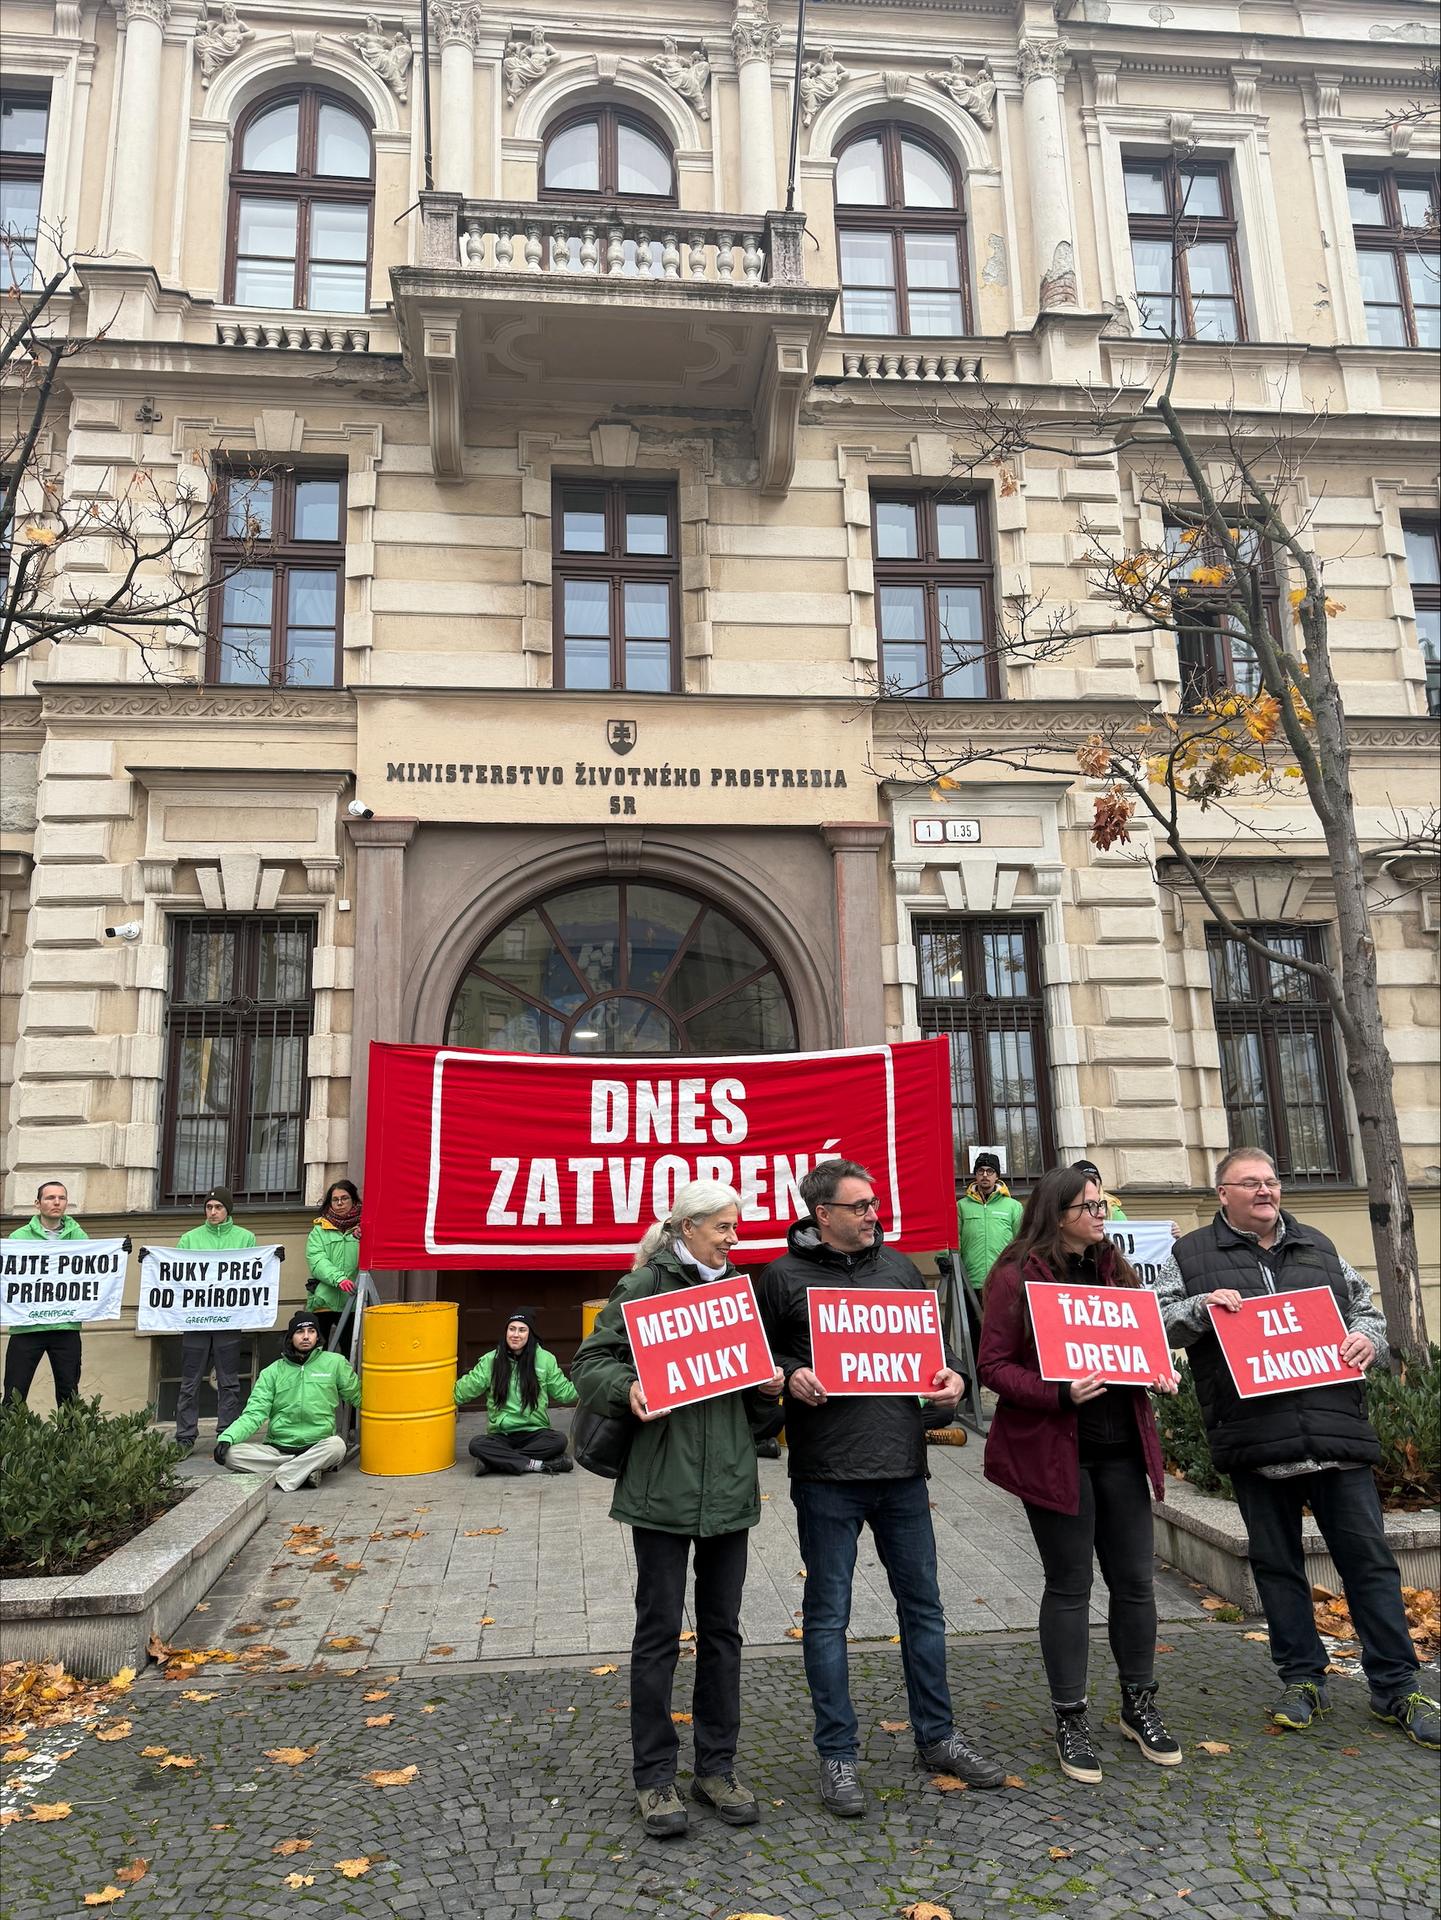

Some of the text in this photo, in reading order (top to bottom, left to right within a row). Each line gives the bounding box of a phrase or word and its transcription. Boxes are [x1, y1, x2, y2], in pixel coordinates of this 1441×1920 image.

[386, 761, 847, 788] MINISTERSTVO ŽIVOTNÉHO PROSTREDIA
[609, 796, 636, 815] SR
[926, 824, 931, 837] 1
[590, 1078, 748, 1144] DNES
[57, 1254, 118, 1275] POKOJ
[160, 1258, 263, 1281] RUKY PREČ
[7, 1278, 98, 1303] PRÍRODE!
[150, 1284, 269, 1309] OD PRÍRODY!
[636, 1292, 753, 1347] MEDVEDE
[818, 1299, 936, 1334] NÁRODNÉ
[1058, 1293, 1140, 1329] ŤAŽBA
[1257, 1301, 1303, 1337] ZLÉ
[666, 1342, 751, 1394] A VLKY
[840, 1352, 922, 1383] PARKY
[1065, 1342, 1150, 1374] DREVA
[1246, 1343, 1343, 1385] ZÁKONY
